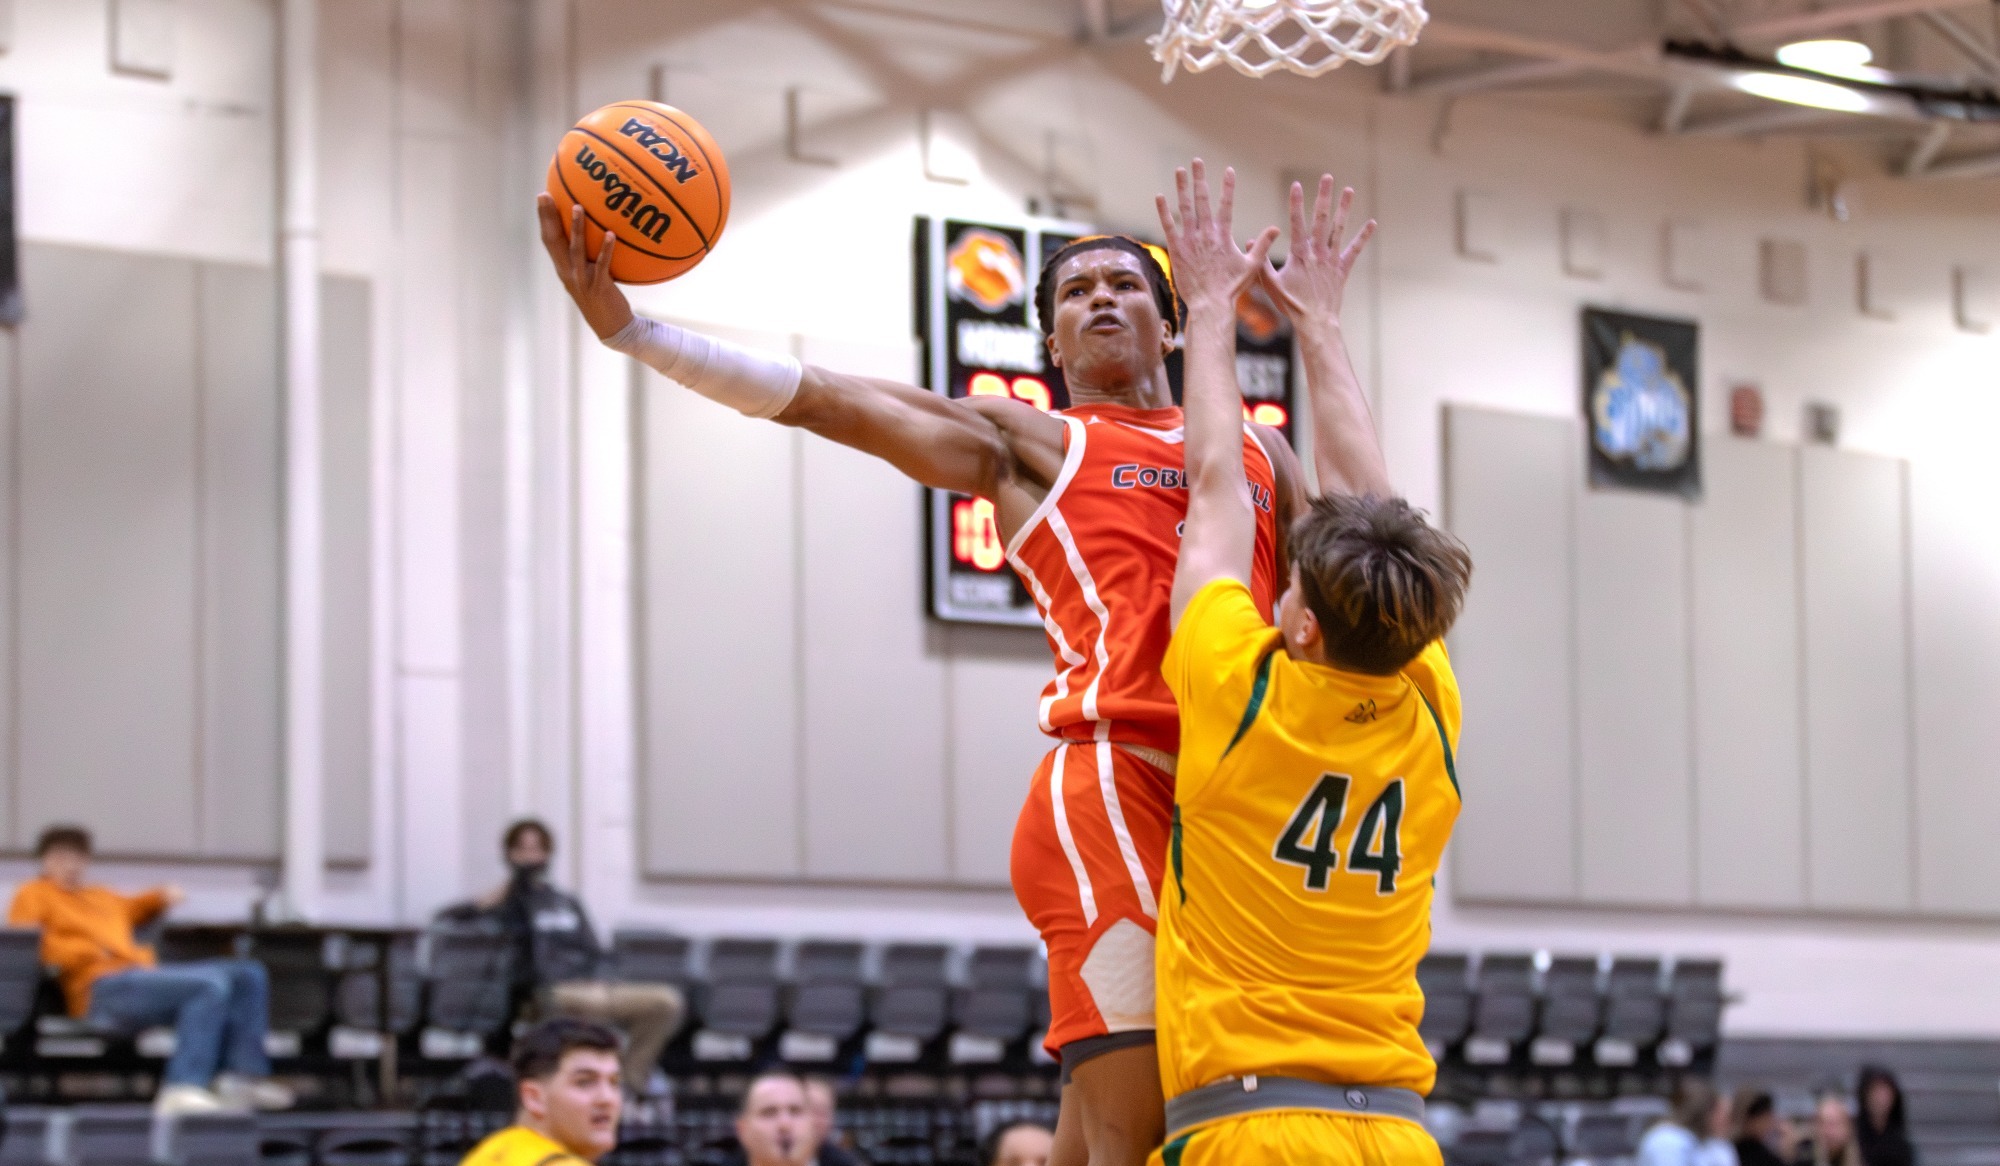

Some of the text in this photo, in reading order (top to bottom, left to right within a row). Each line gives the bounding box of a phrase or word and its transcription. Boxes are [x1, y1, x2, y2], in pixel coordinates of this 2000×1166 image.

[575, 144, 672, 244] Wilson
[619, 117, 699, 185] NCAA
[1273, 771, 1405, 895] 44
